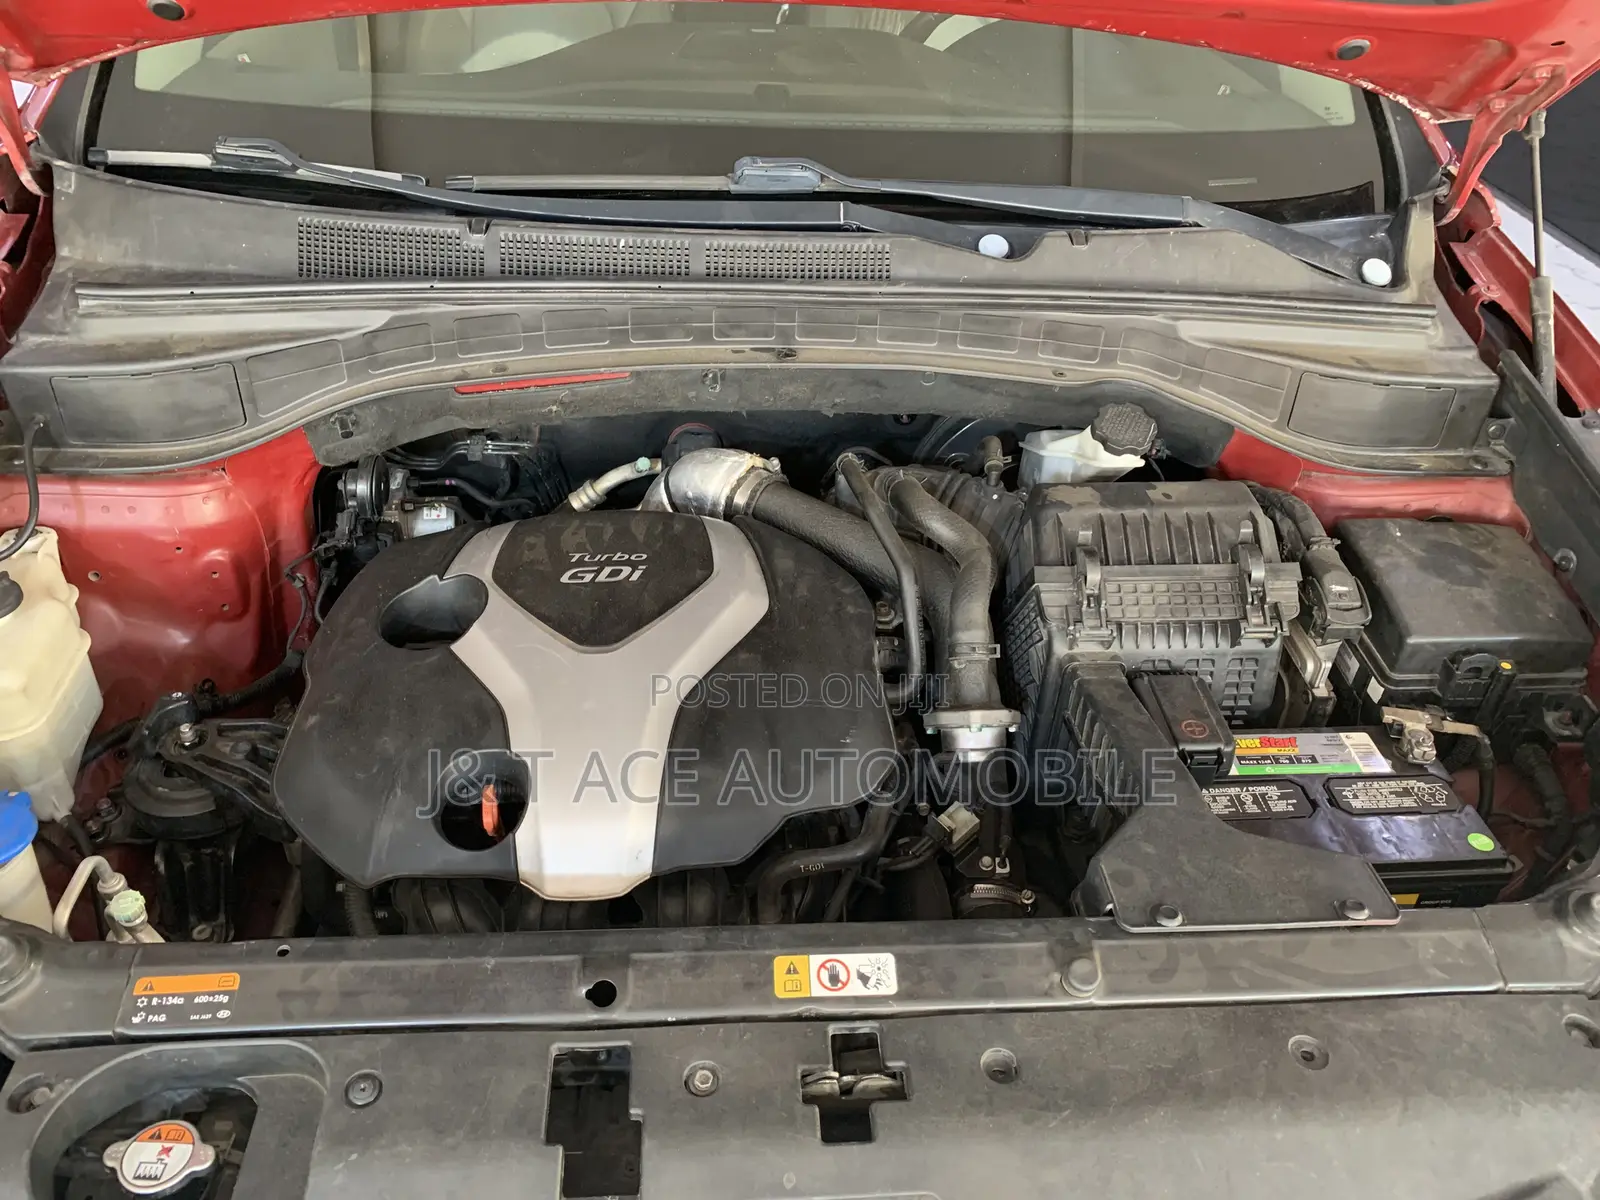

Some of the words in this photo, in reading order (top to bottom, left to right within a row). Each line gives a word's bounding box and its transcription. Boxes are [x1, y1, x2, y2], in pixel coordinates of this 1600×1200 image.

[569, 552, 648, 562] Turbo
[560, 565, 648, 583] GDi
[1209, 786, 1241, 794] DANGER
[151, 996, 184, 1006] R-134a
[147, 1014, 167, 1022] PAG
